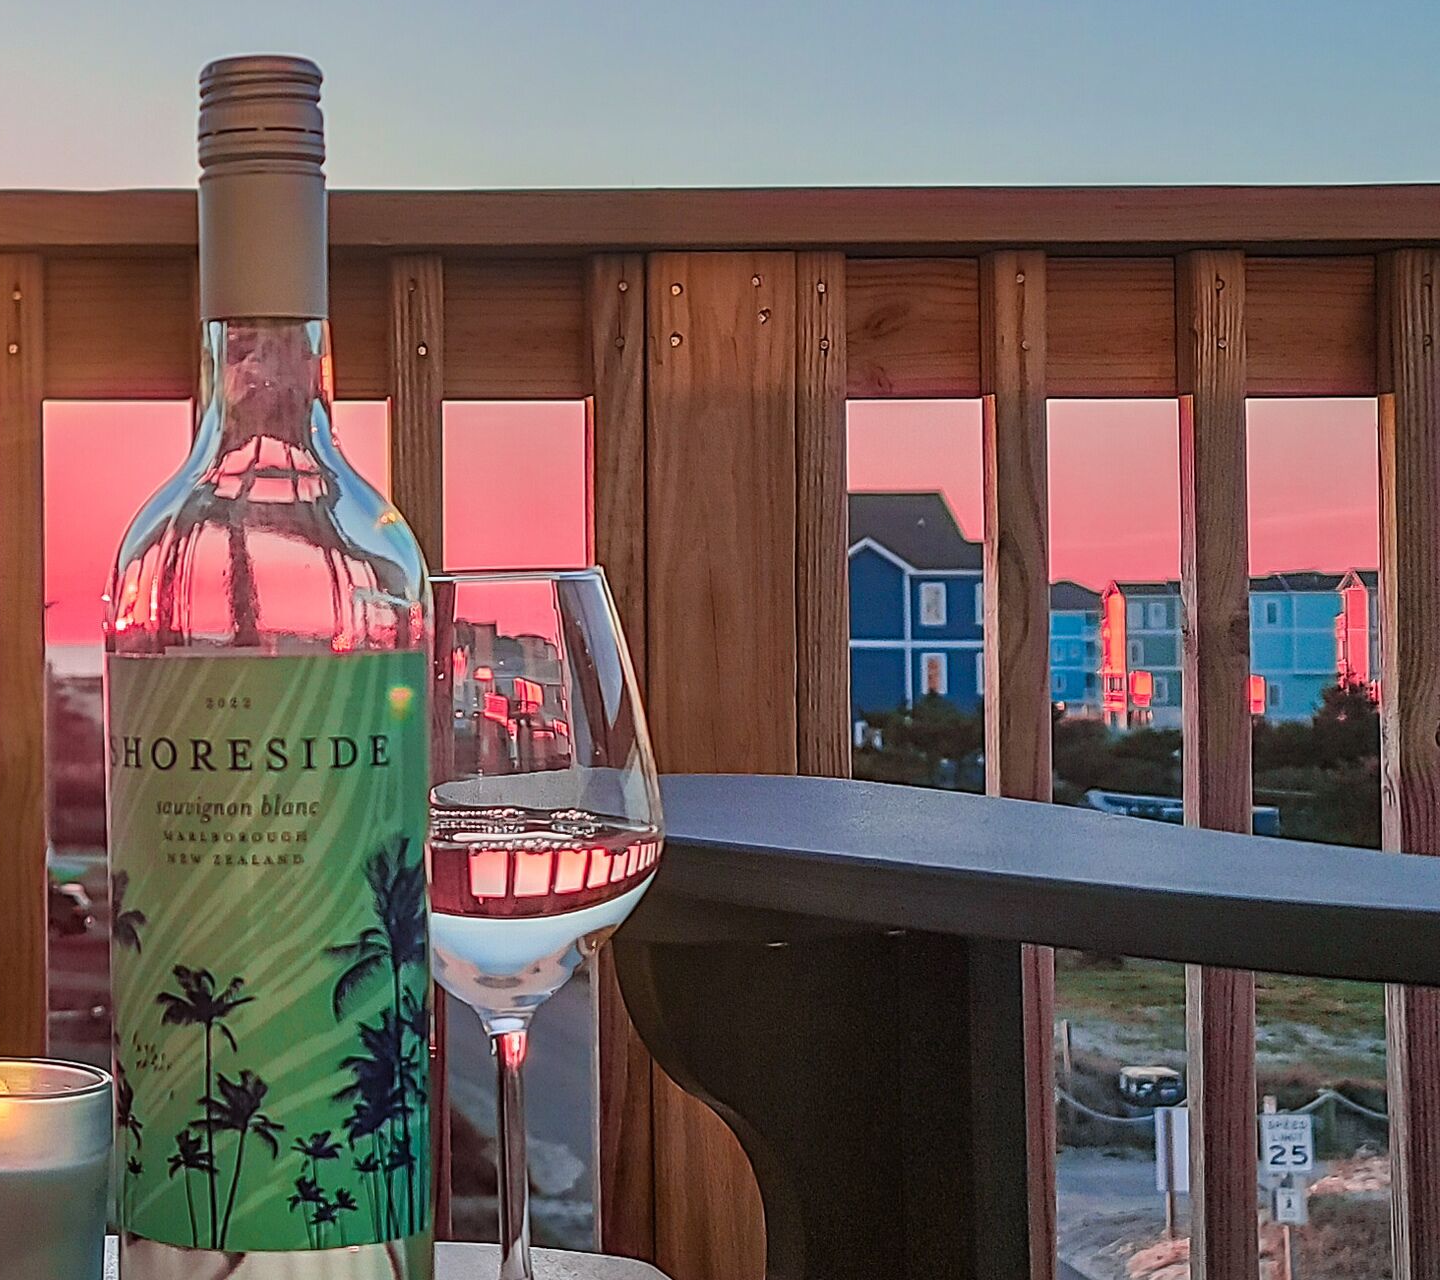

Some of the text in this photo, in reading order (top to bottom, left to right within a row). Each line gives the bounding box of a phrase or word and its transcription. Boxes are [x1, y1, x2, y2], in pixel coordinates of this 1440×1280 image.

[156, 794, 319, 822] sauvignon blanc
[164, 830, 308, 842] MARLBOROUGH
[167, 853, 304, 865] NEW ZEALAND
[1268, 1121, 1307, 1129] SPEED
[1269, 1145, 1308, 1165] 25
